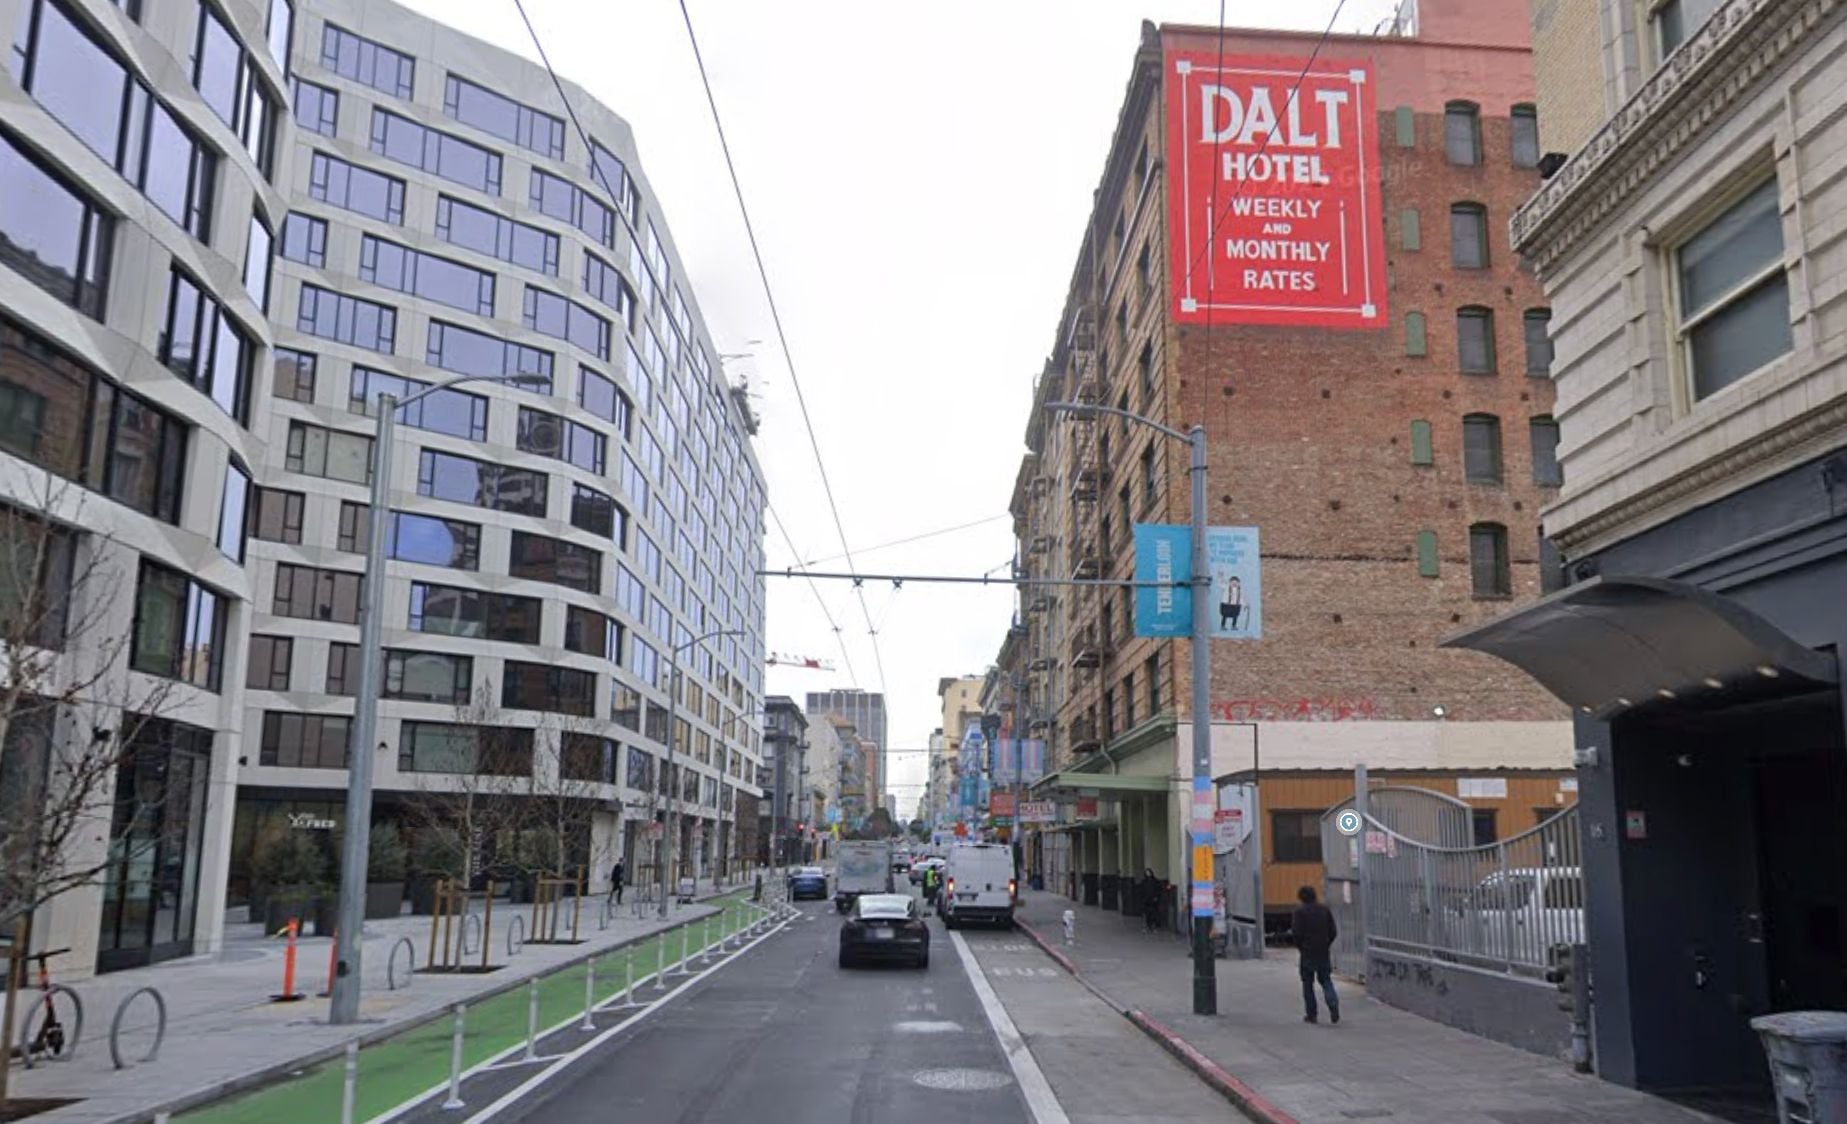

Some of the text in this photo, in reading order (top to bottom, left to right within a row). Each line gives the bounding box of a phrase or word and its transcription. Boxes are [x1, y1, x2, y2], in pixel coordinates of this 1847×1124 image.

[1199, 84, 1348, 149] DALT
[1222, 152, 1330, 184] HOTEL
[1232, 197, 1322, 219] WEEKLY
[1262, 222, 1292, 234] AND
[1226, 239, 1331, 262] MONTHLY
[1243, 269, 1316, 291] RATES
[993, 967, 1058, 977] BUS
